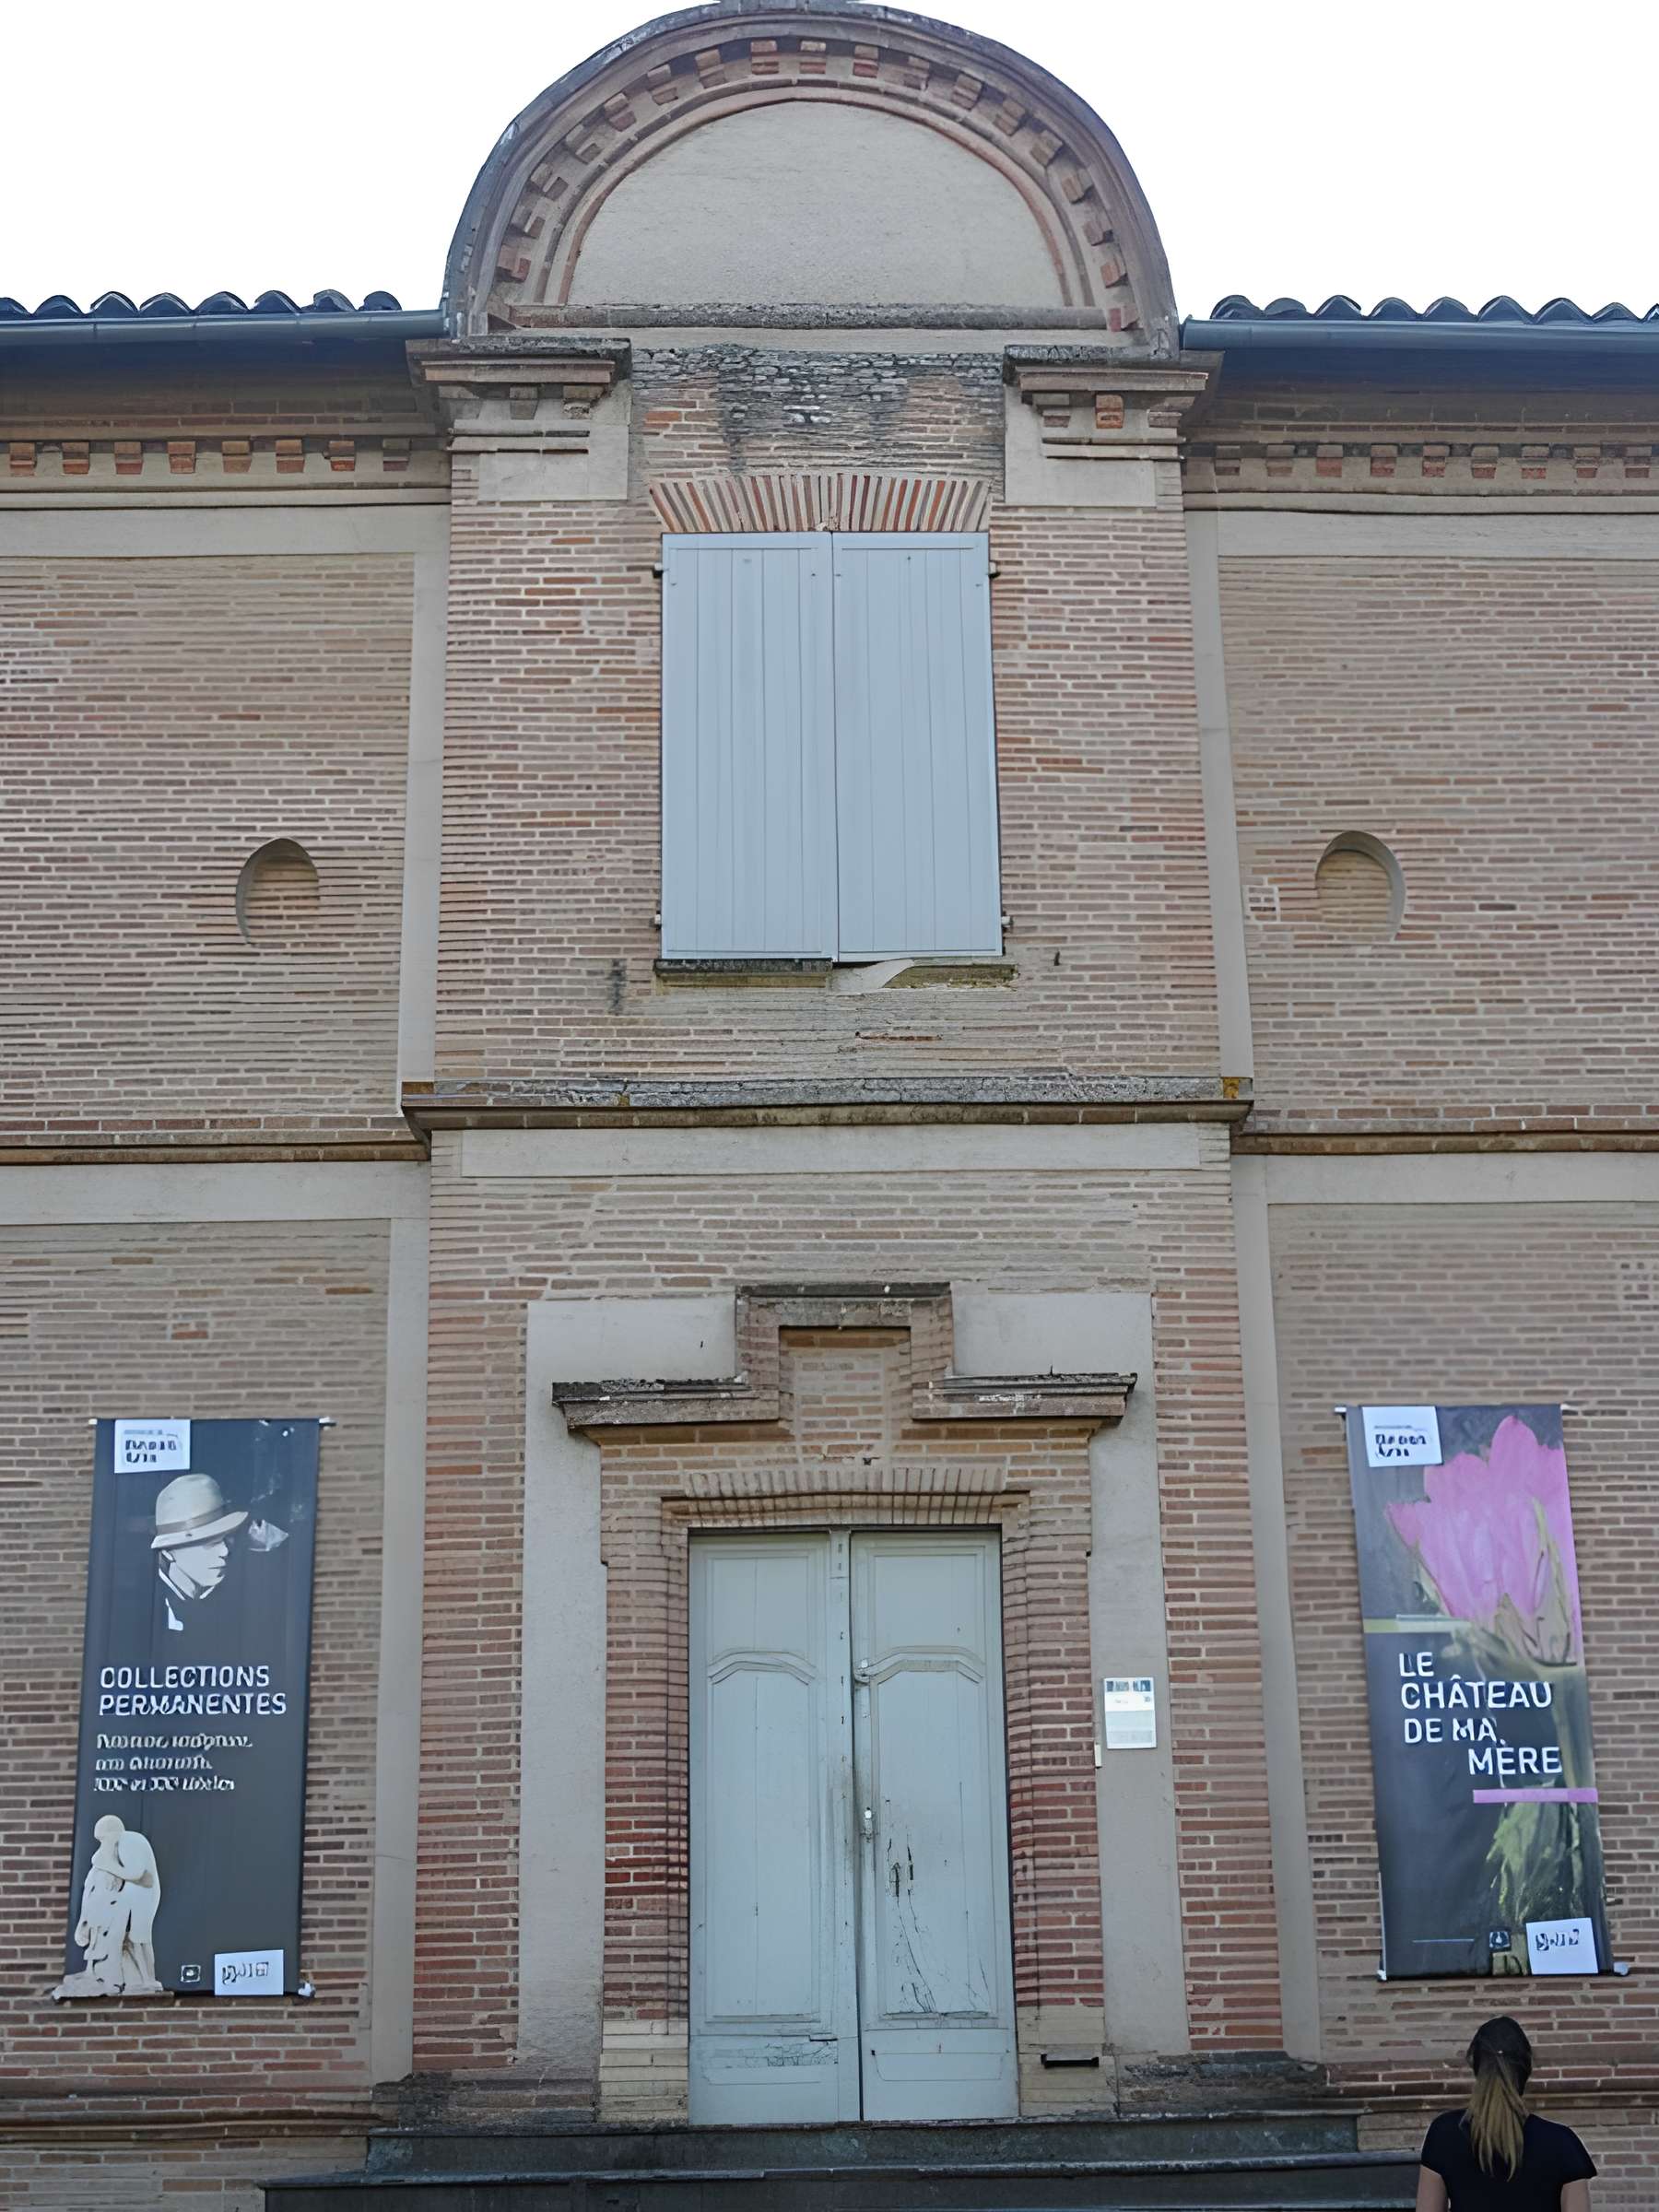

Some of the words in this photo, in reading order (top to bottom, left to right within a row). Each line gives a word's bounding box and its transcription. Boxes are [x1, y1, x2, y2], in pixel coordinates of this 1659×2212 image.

[1399, 1652, 1435, 1677] LE
[1401, 1674, 1553, 1710] CHÂTEAU
[1404, 1717, 1443, 1744] DE
[1452, 1717, 1498, 1744] MA
[1468, 1738, 1563, 1776] MÈRE
